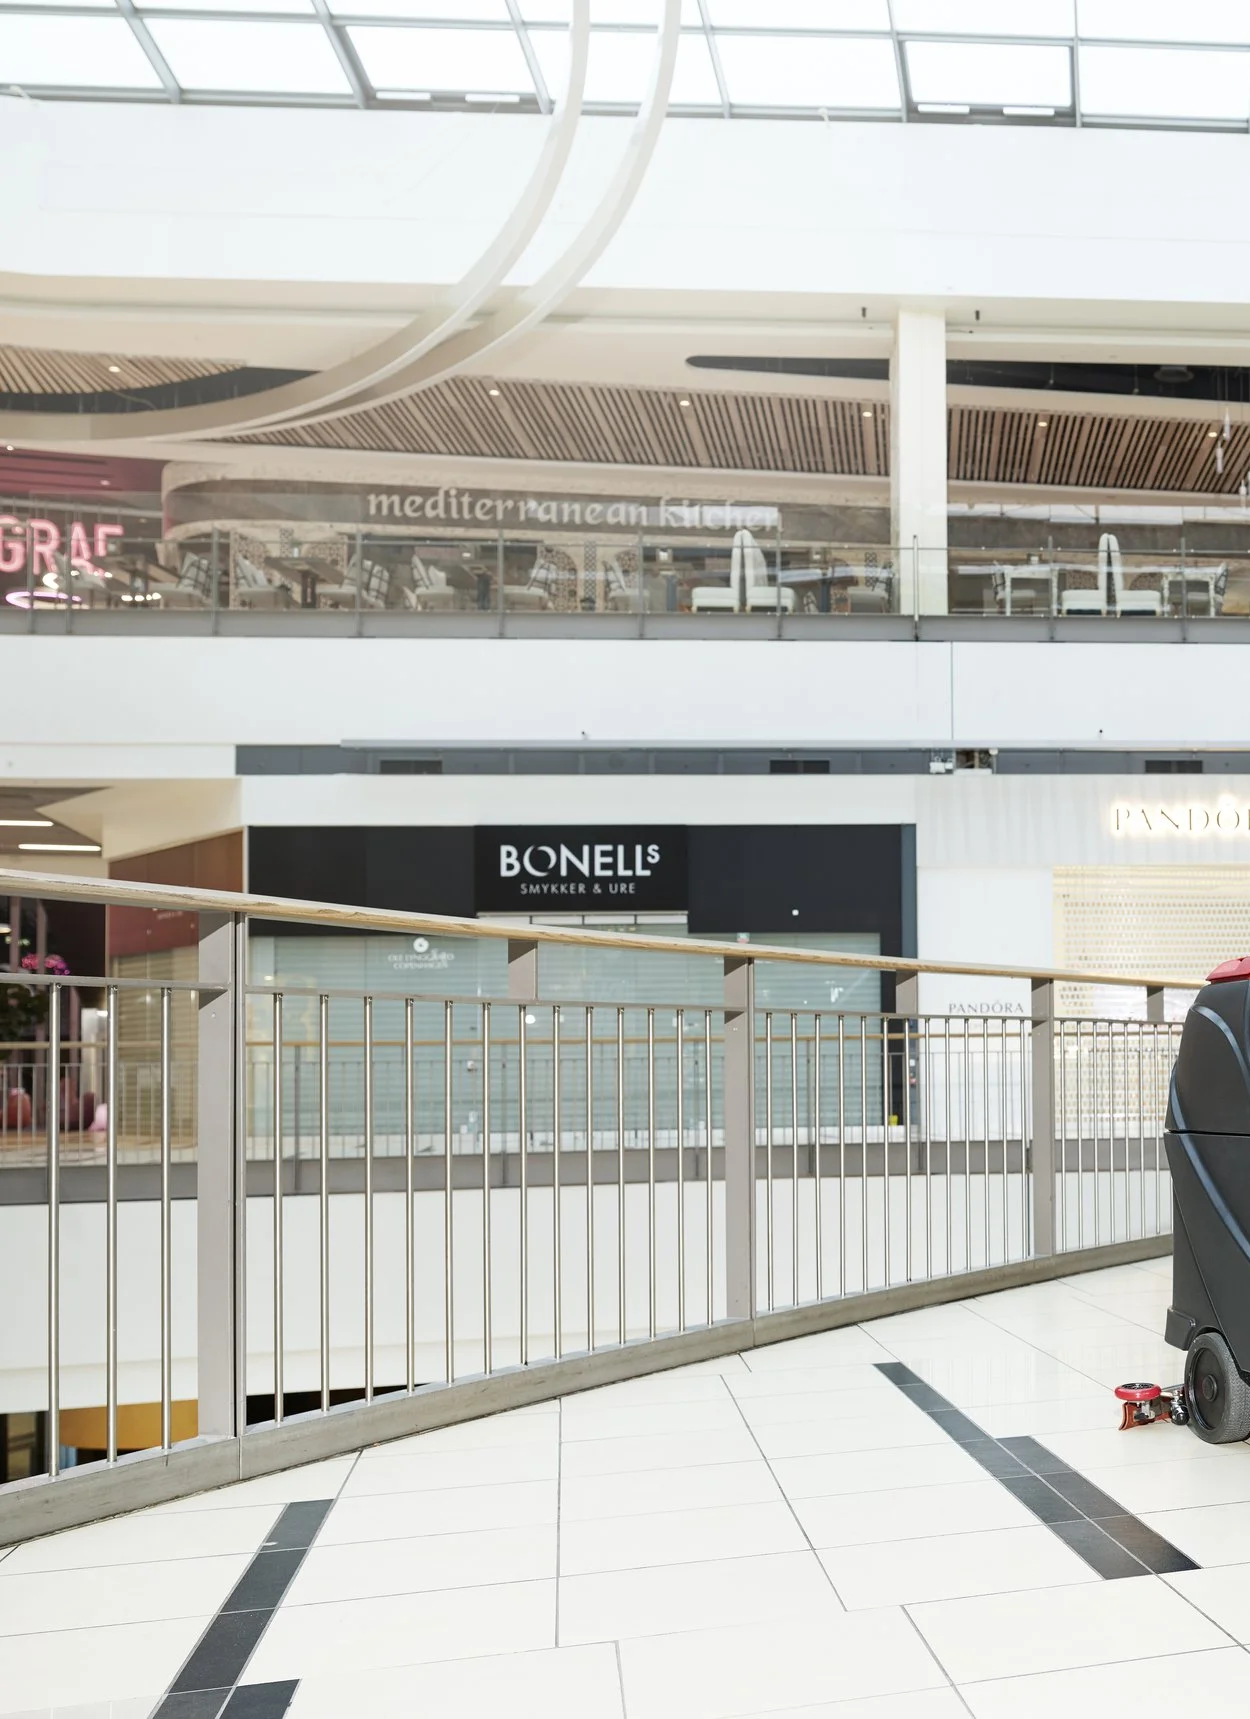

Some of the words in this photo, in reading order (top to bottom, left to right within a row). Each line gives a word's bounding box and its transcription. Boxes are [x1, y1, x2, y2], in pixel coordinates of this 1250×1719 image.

[368, 486, 648, 527] mediterranean
[520, 883, 586, 895] SMYKKER
[592, 883, 602, 895] &
[609, 883, 636, 895] URE
